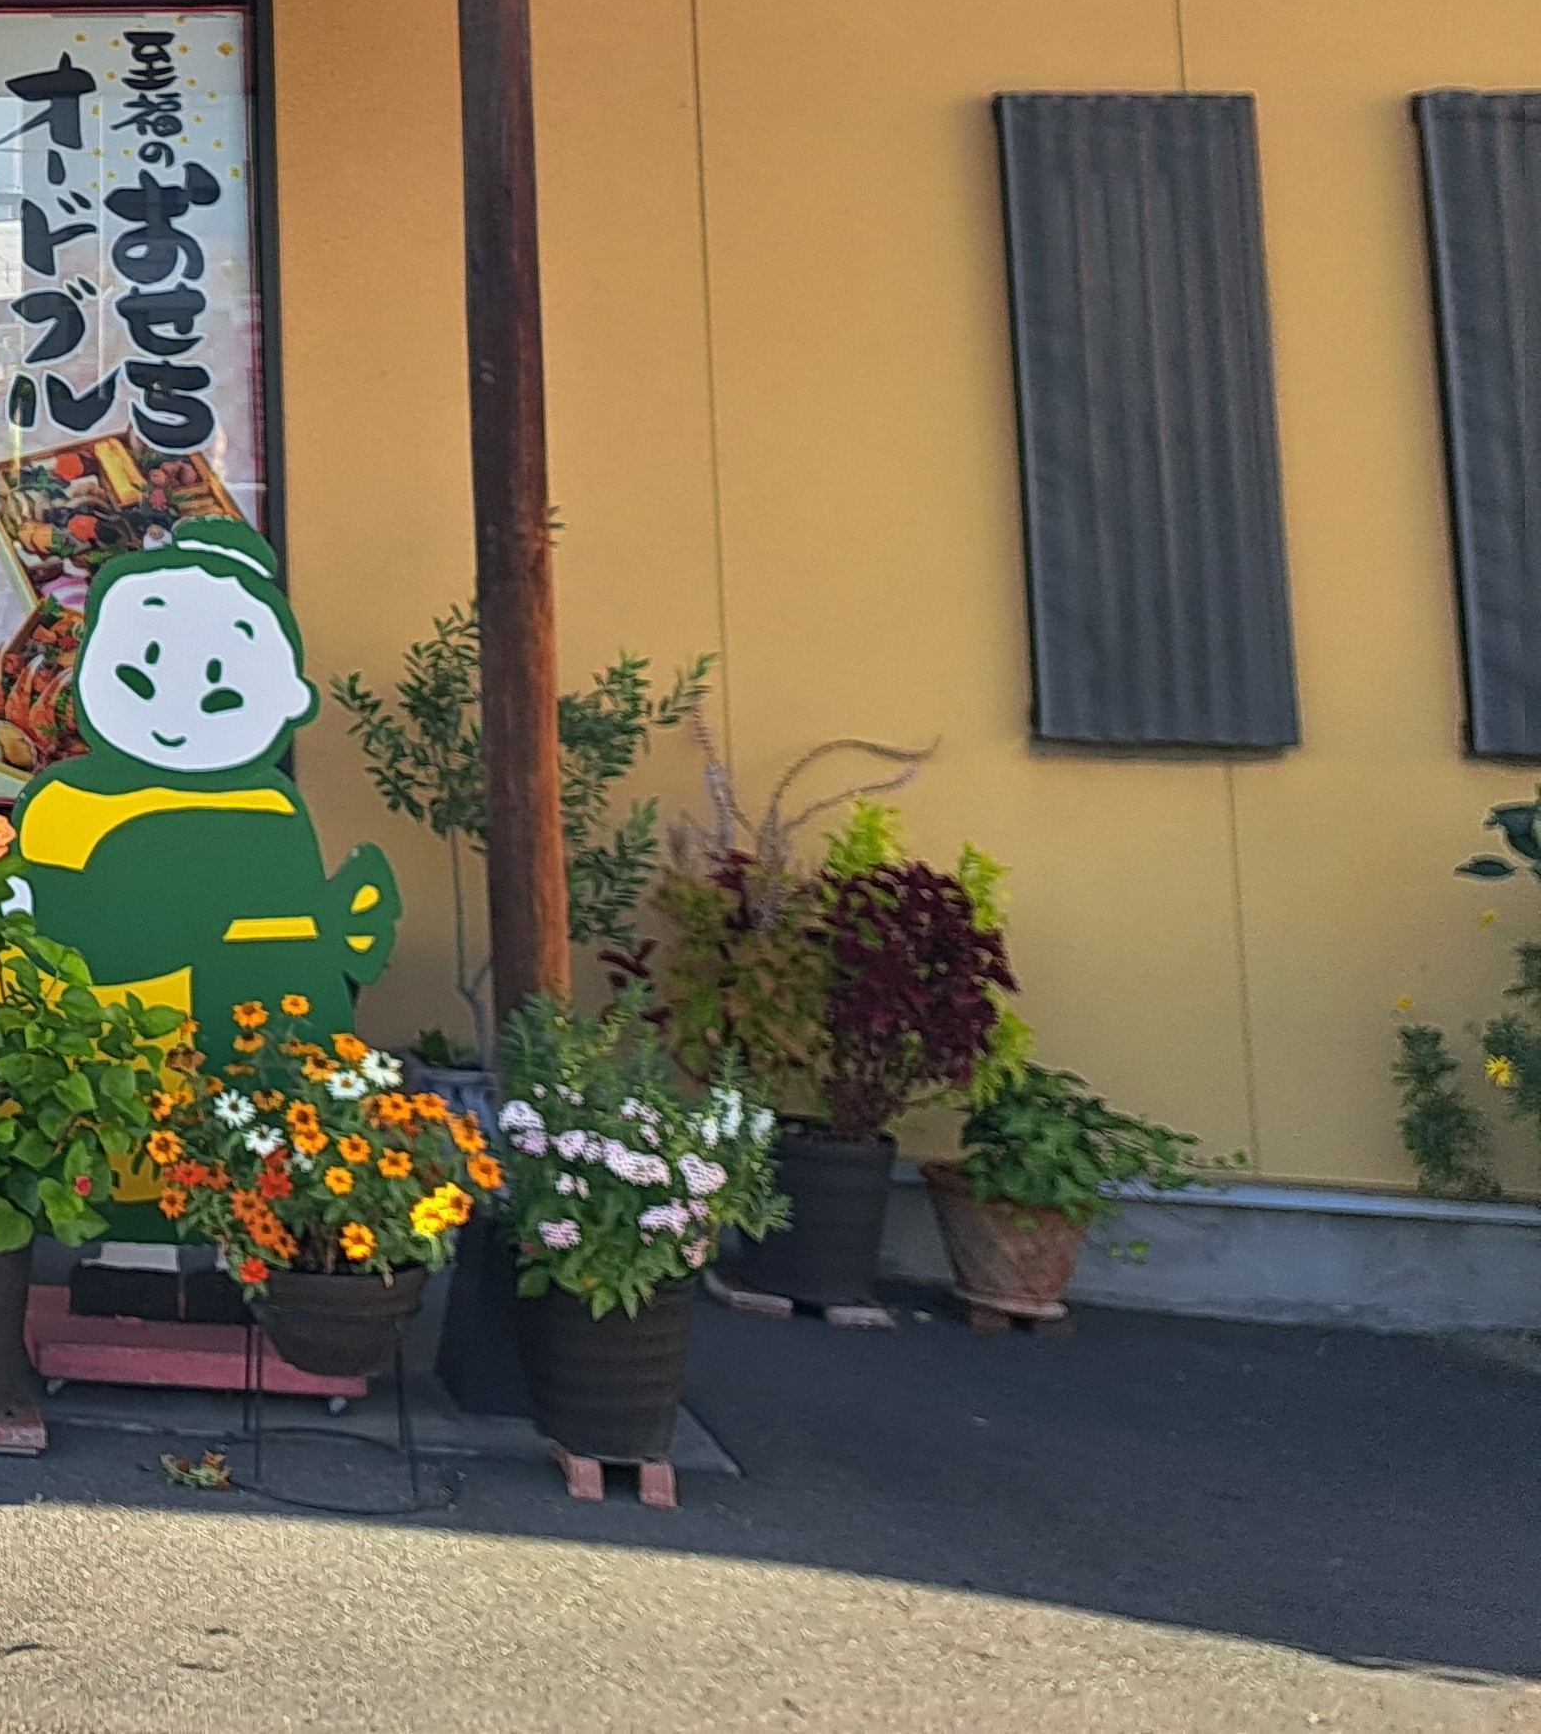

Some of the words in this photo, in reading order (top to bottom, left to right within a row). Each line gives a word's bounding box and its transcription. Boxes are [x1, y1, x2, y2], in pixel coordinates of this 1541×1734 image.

[104, 31, 221, 449] 至福のおせち
